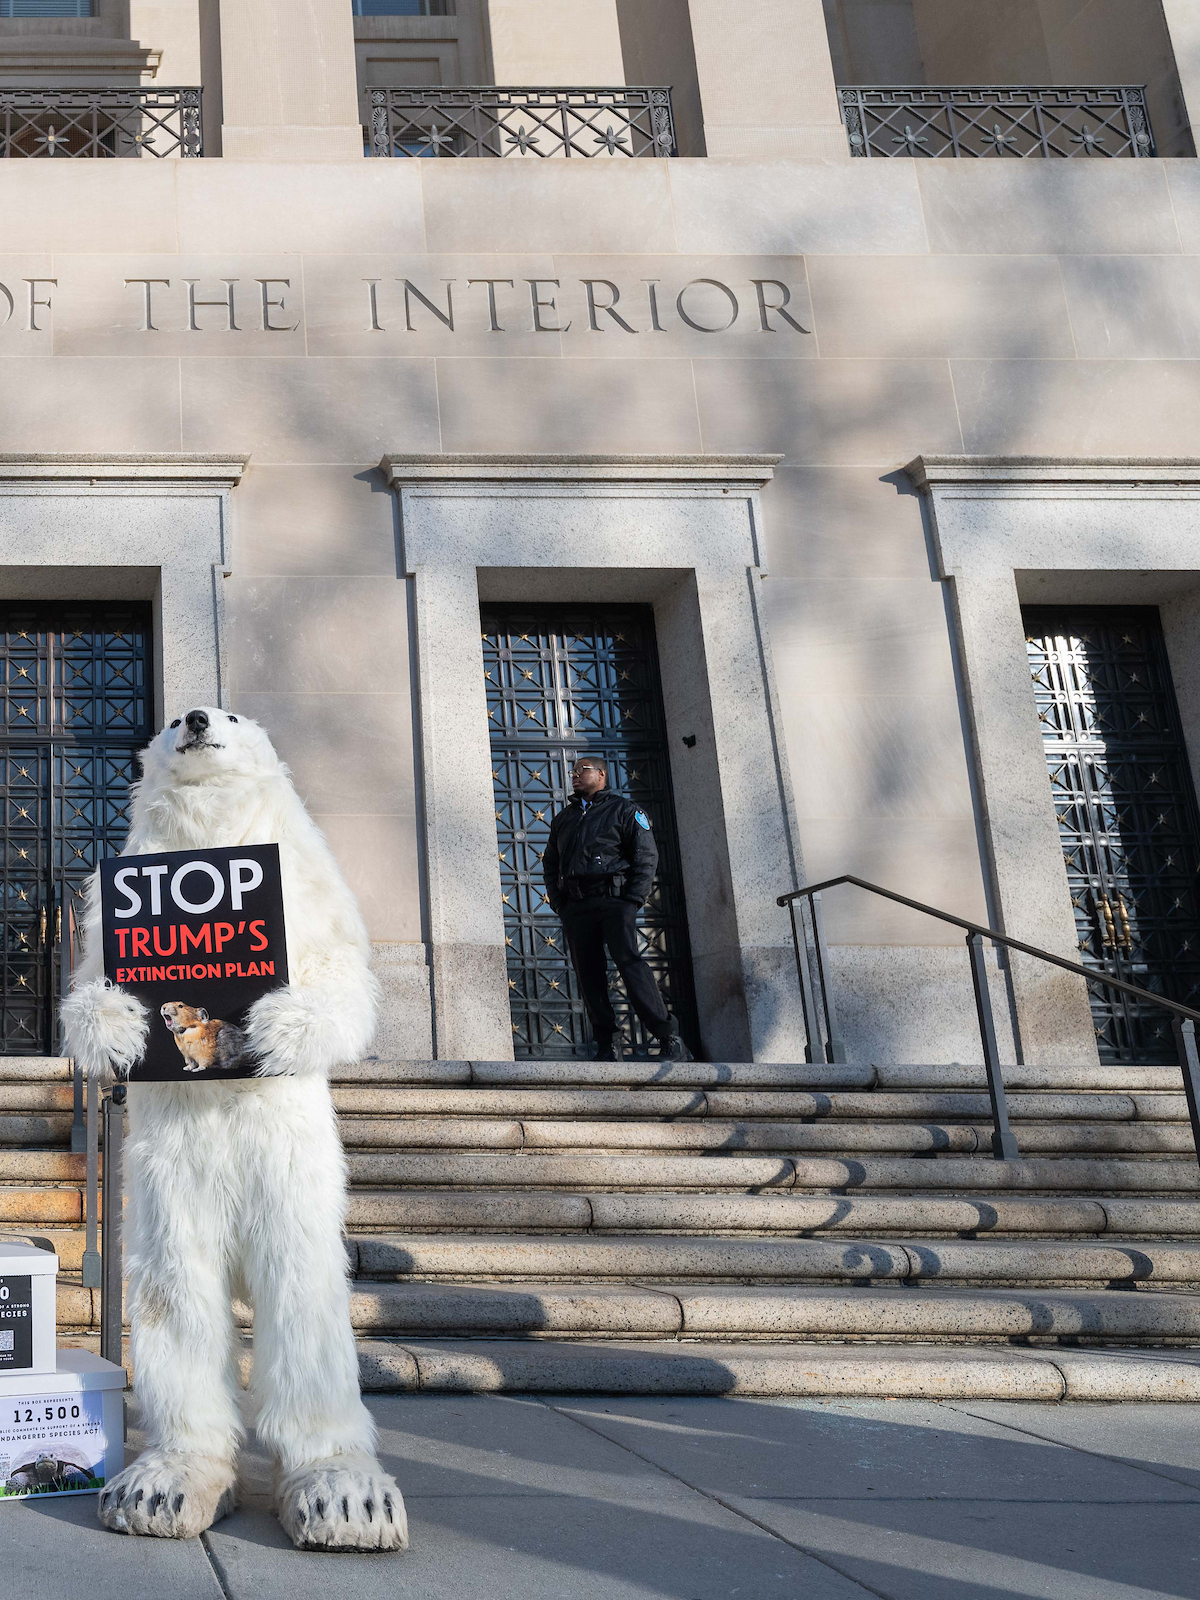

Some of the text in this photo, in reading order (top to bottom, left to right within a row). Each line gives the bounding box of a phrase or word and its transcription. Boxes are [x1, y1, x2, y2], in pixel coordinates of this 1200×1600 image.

[123, 278, 300, 331] THE
[360, 278, 811, 334] INTERIOR
[114, 859, 263, 918] STOP
[115, 920, 268, 958] TRUMP'S
[117, 961, 275, 982] EXTINCTION PLAN
[14, 1406, 80, 1422] 12,500
